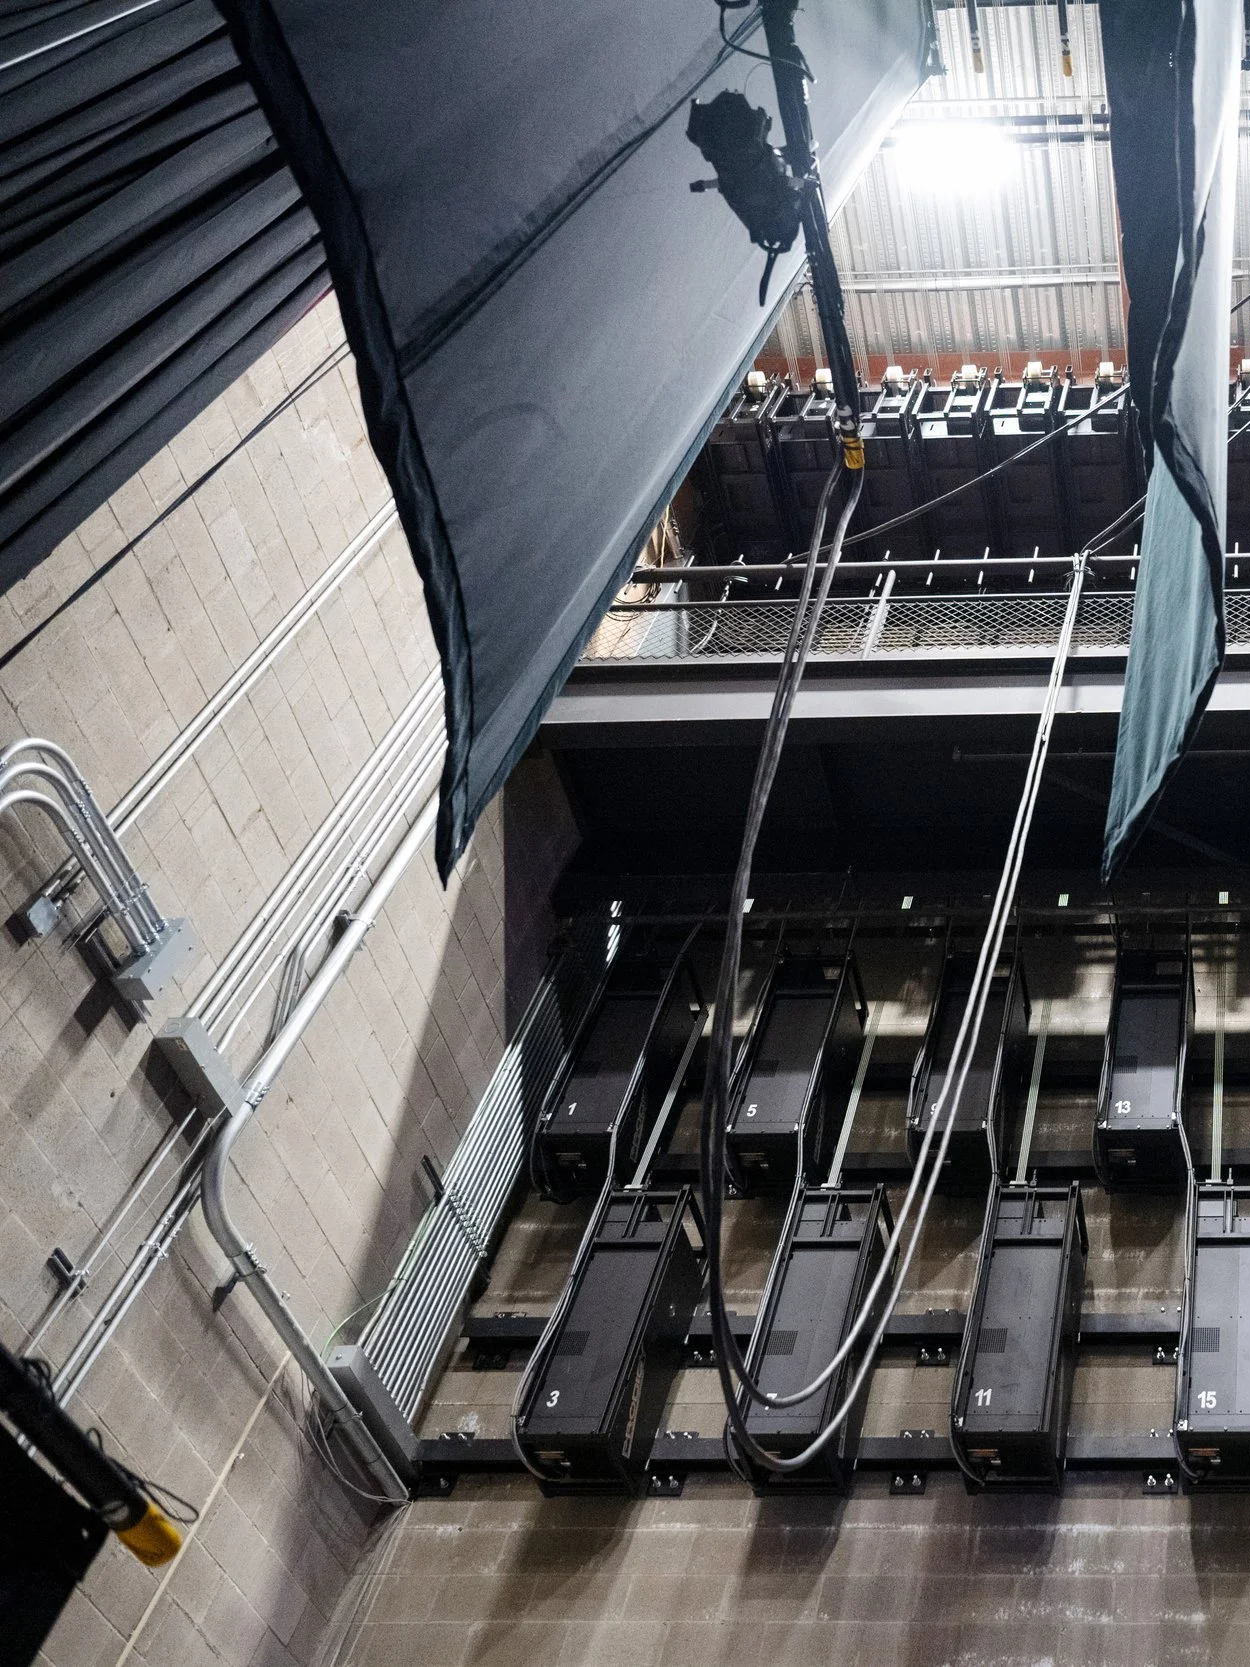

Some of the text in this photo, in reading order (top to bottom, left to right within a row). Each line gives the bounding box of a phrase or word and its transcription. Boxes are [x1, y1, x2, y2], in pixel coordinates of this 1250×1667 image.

[568, 1102, 577, 1116] 1
[746, 1103, 758, 1117] 5
[1114, 1100, 1131, 1114] 13
[546, 1390, 560, 1408] 3
[974, 1388, 993, 1407] 11
[1197, 1390, 1217, 1409] 15
